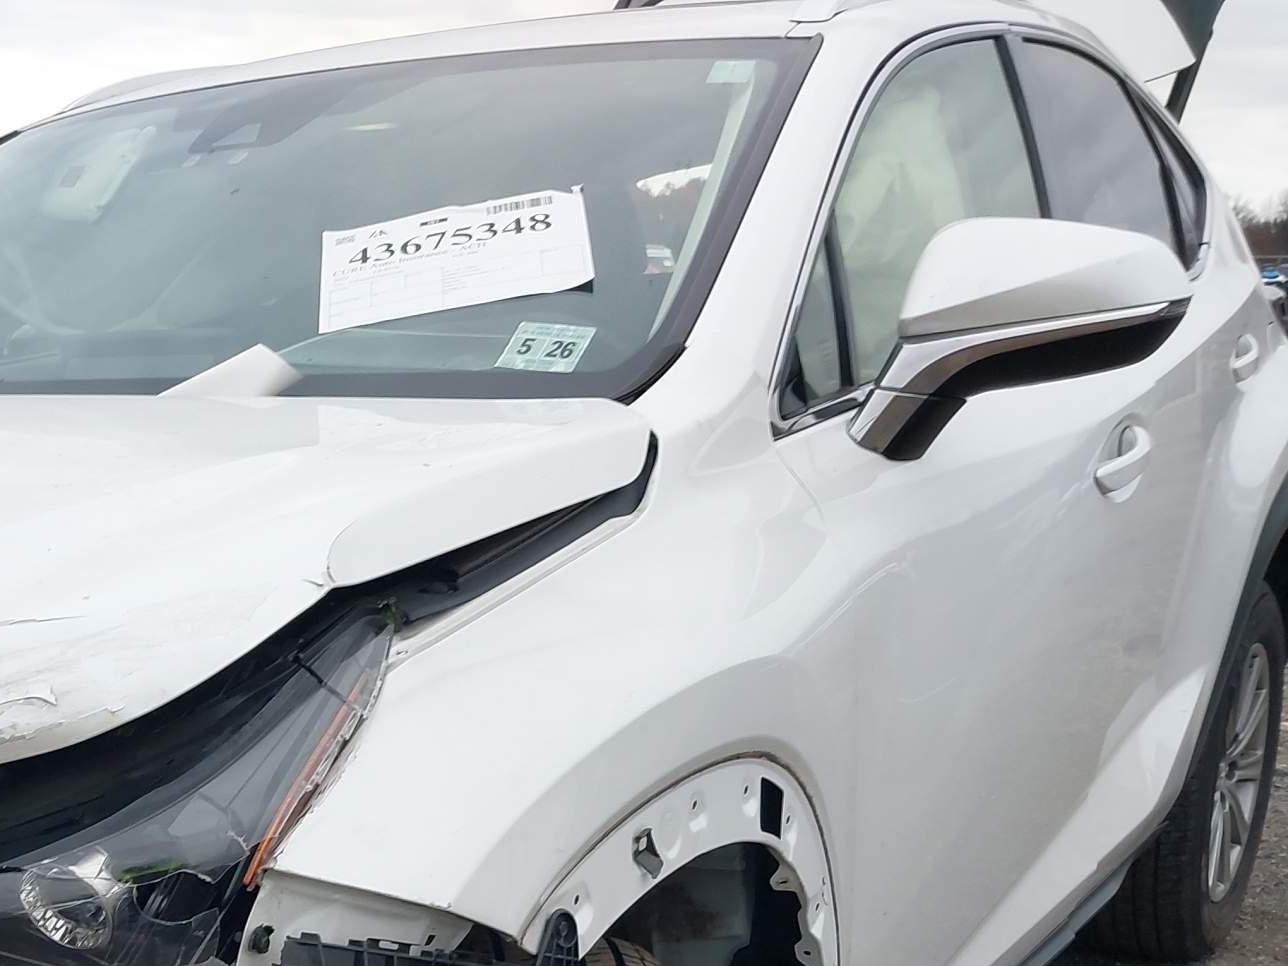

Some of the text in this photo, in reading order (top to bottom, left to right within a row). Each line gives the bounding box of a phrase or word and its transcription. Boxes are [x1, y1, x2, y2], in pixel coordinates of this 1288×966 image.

[348, 213, 553, 265] 43675348
[516, 337, 578, 360] 5 26
